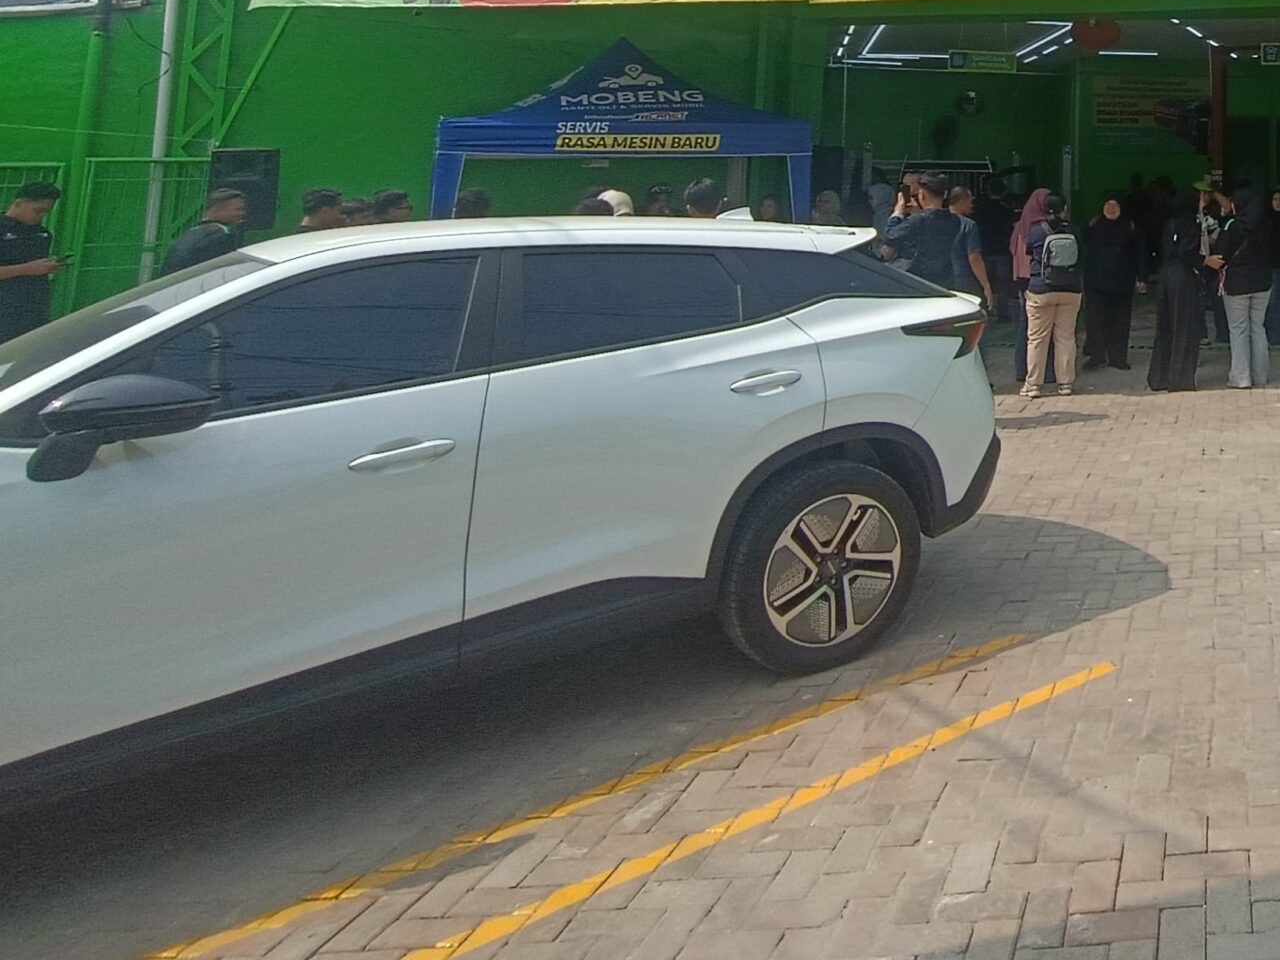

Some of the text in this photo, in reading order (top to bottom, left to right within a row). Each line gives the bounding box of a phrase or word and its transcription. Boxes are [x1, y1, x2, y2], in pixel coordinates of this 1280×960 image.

[560, 90, 704, 107] MOBENG
[556, 121, 610, 134] SERVIS
[559, 136, 718, 149] RASA MESIN BARU
